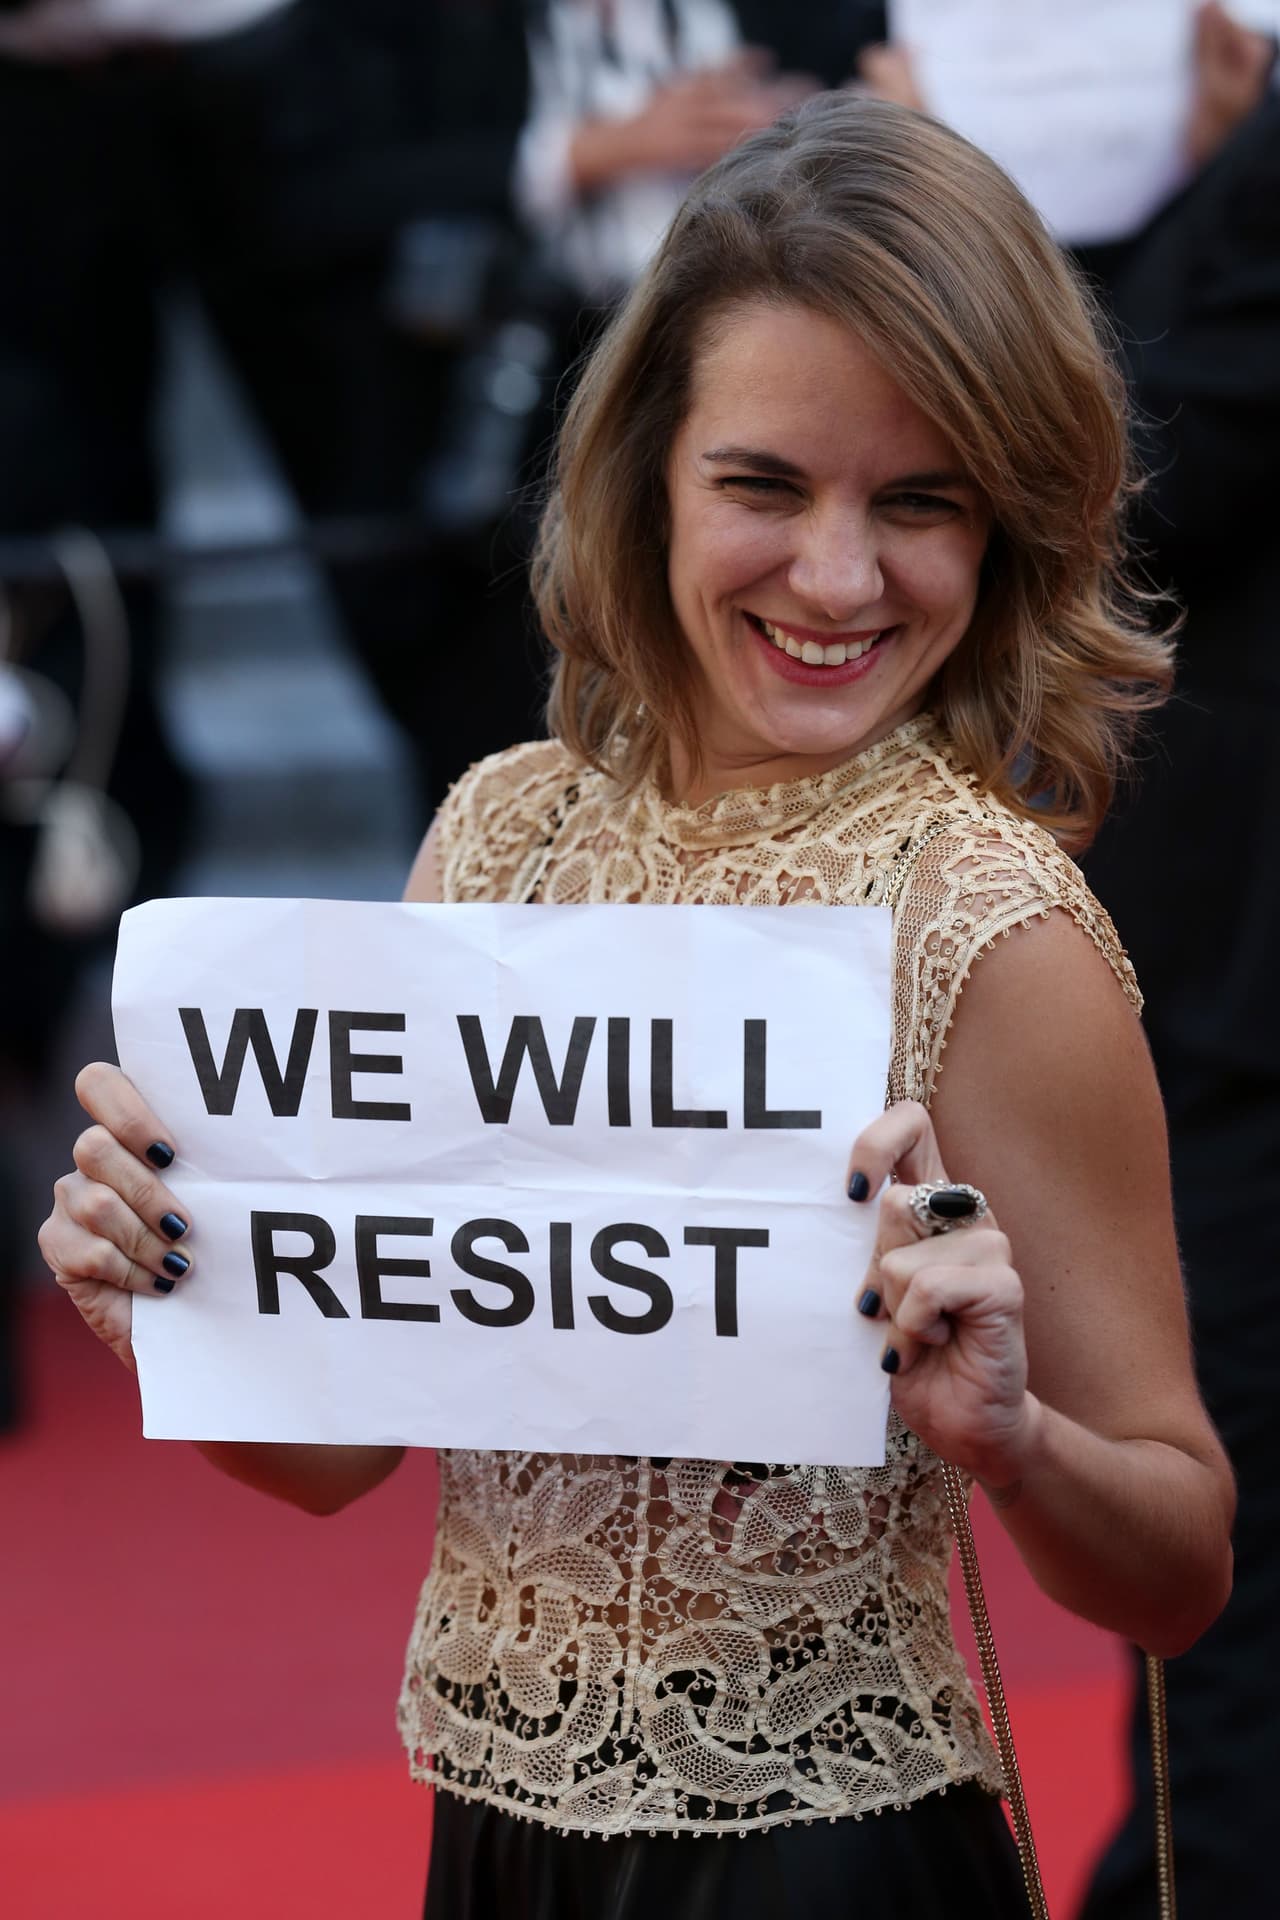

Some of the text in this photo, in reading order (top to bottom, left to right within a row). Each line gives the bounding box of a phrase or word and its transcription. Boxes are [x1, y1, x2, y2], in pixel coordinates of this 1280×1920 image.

[178, 1007, 822, 1130] WE WILL
[250, 1210, 770, 1338] RESIST
